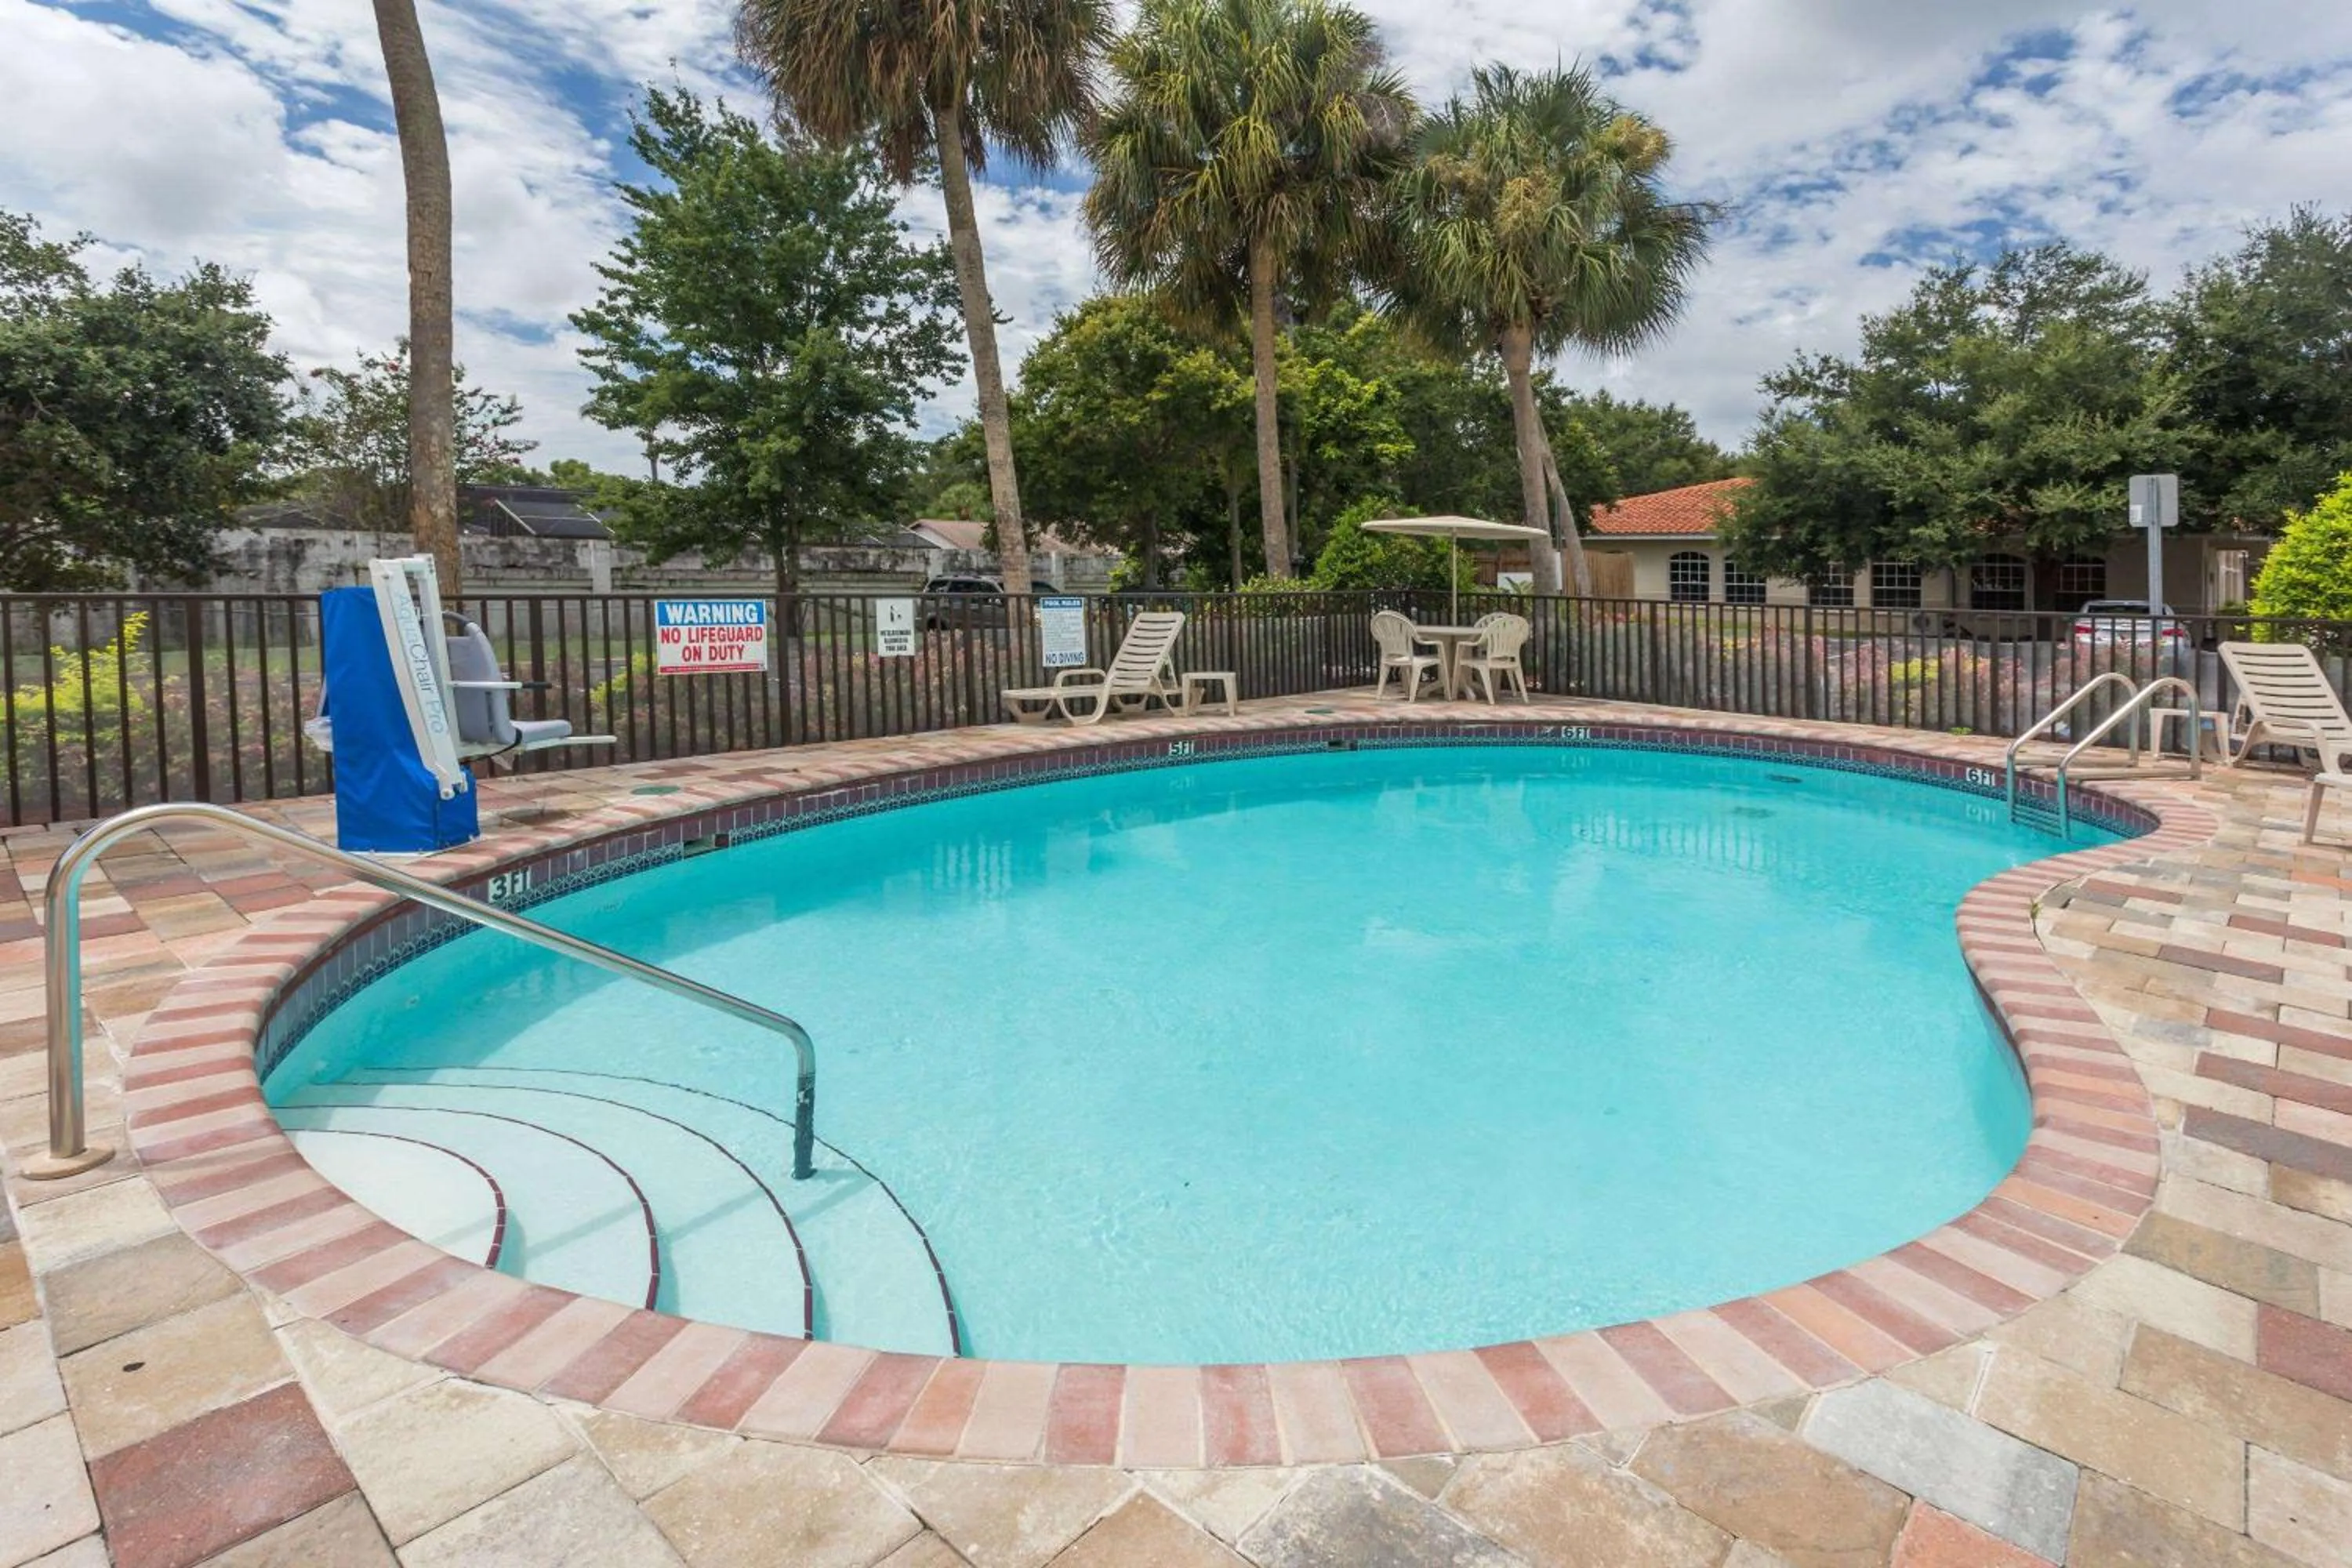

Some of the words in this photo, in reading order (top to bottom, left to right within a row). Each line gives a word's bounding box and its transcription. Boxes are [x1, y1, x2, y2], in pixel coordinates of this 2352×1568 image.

[665, 603, 758, 624] WARNING
[661, 628, 681, 644] NO
[688, 626, 763, 643] LIFEGUARD
[682, 645, 702, 662] ON
[708, 644, 745, 660] DUTY
[1046, 652, 1058, 664] NO
[1058, 652, 1084, 664] DIVING
[426, 698, 444, 734] Pro
